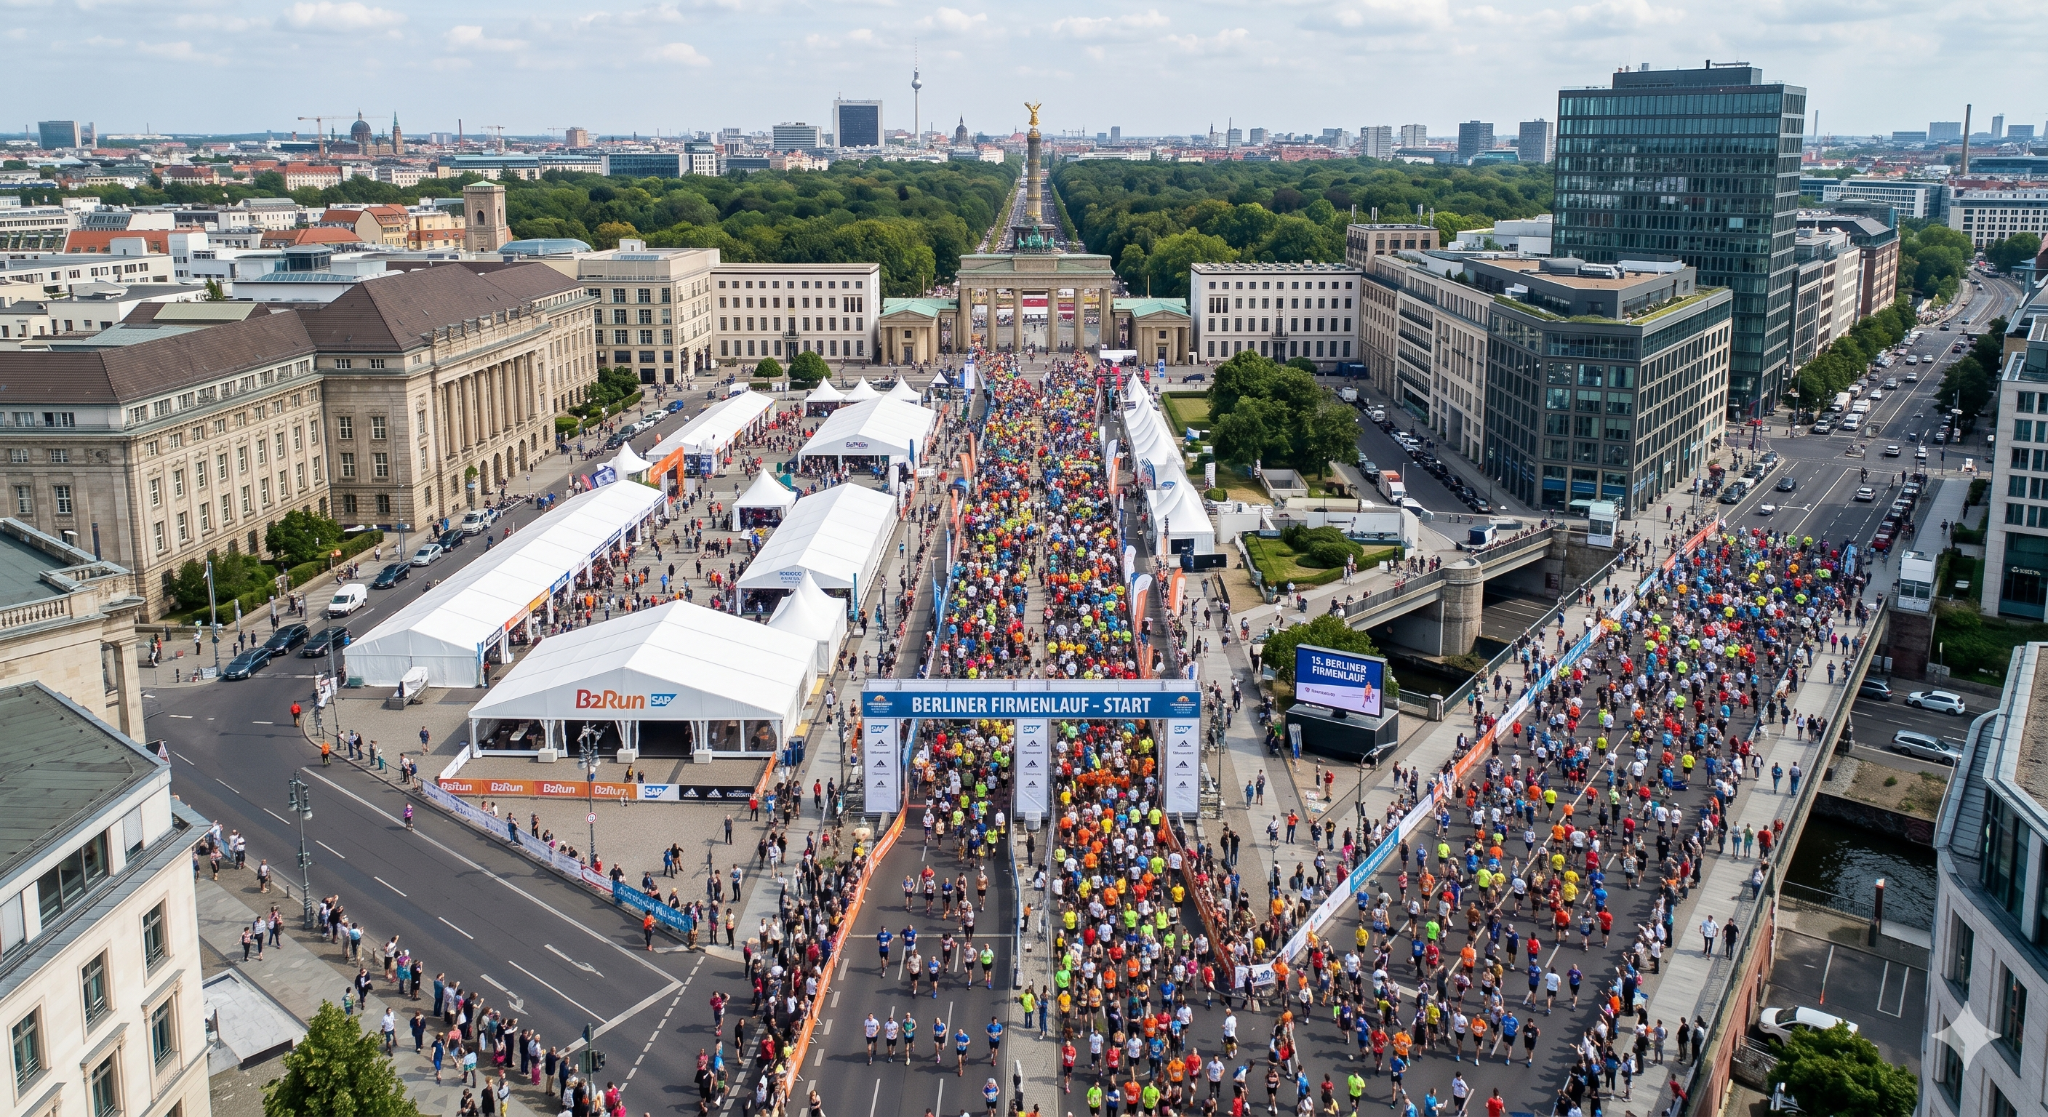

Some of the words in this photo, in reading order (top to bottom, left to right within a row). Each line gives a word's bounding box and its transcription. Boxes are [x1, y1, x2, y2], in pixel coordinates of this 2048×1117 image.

[1325, 658, 1367, 673] BERLINER
[1312, 665, 1365, 683] FIRMENLAUF
[575, 689, 645, 709] B2Run
[651, 695, 673, 706] SAP
[912, 697, 987, 713] BERLINER
[992, 697, 1089, 713] FIRMENLAUF
[1104, 697, 1151, 713] START
[871, 725, 886, 733] SAP
[1024, 725, 1039, 733] SAP
[1175, 726, 1189, 734] SAP
[491, 782, 523, 792] B2Run
[543, 783, 575, 793] B2Run
[645, 786, 665, 798] SAP
